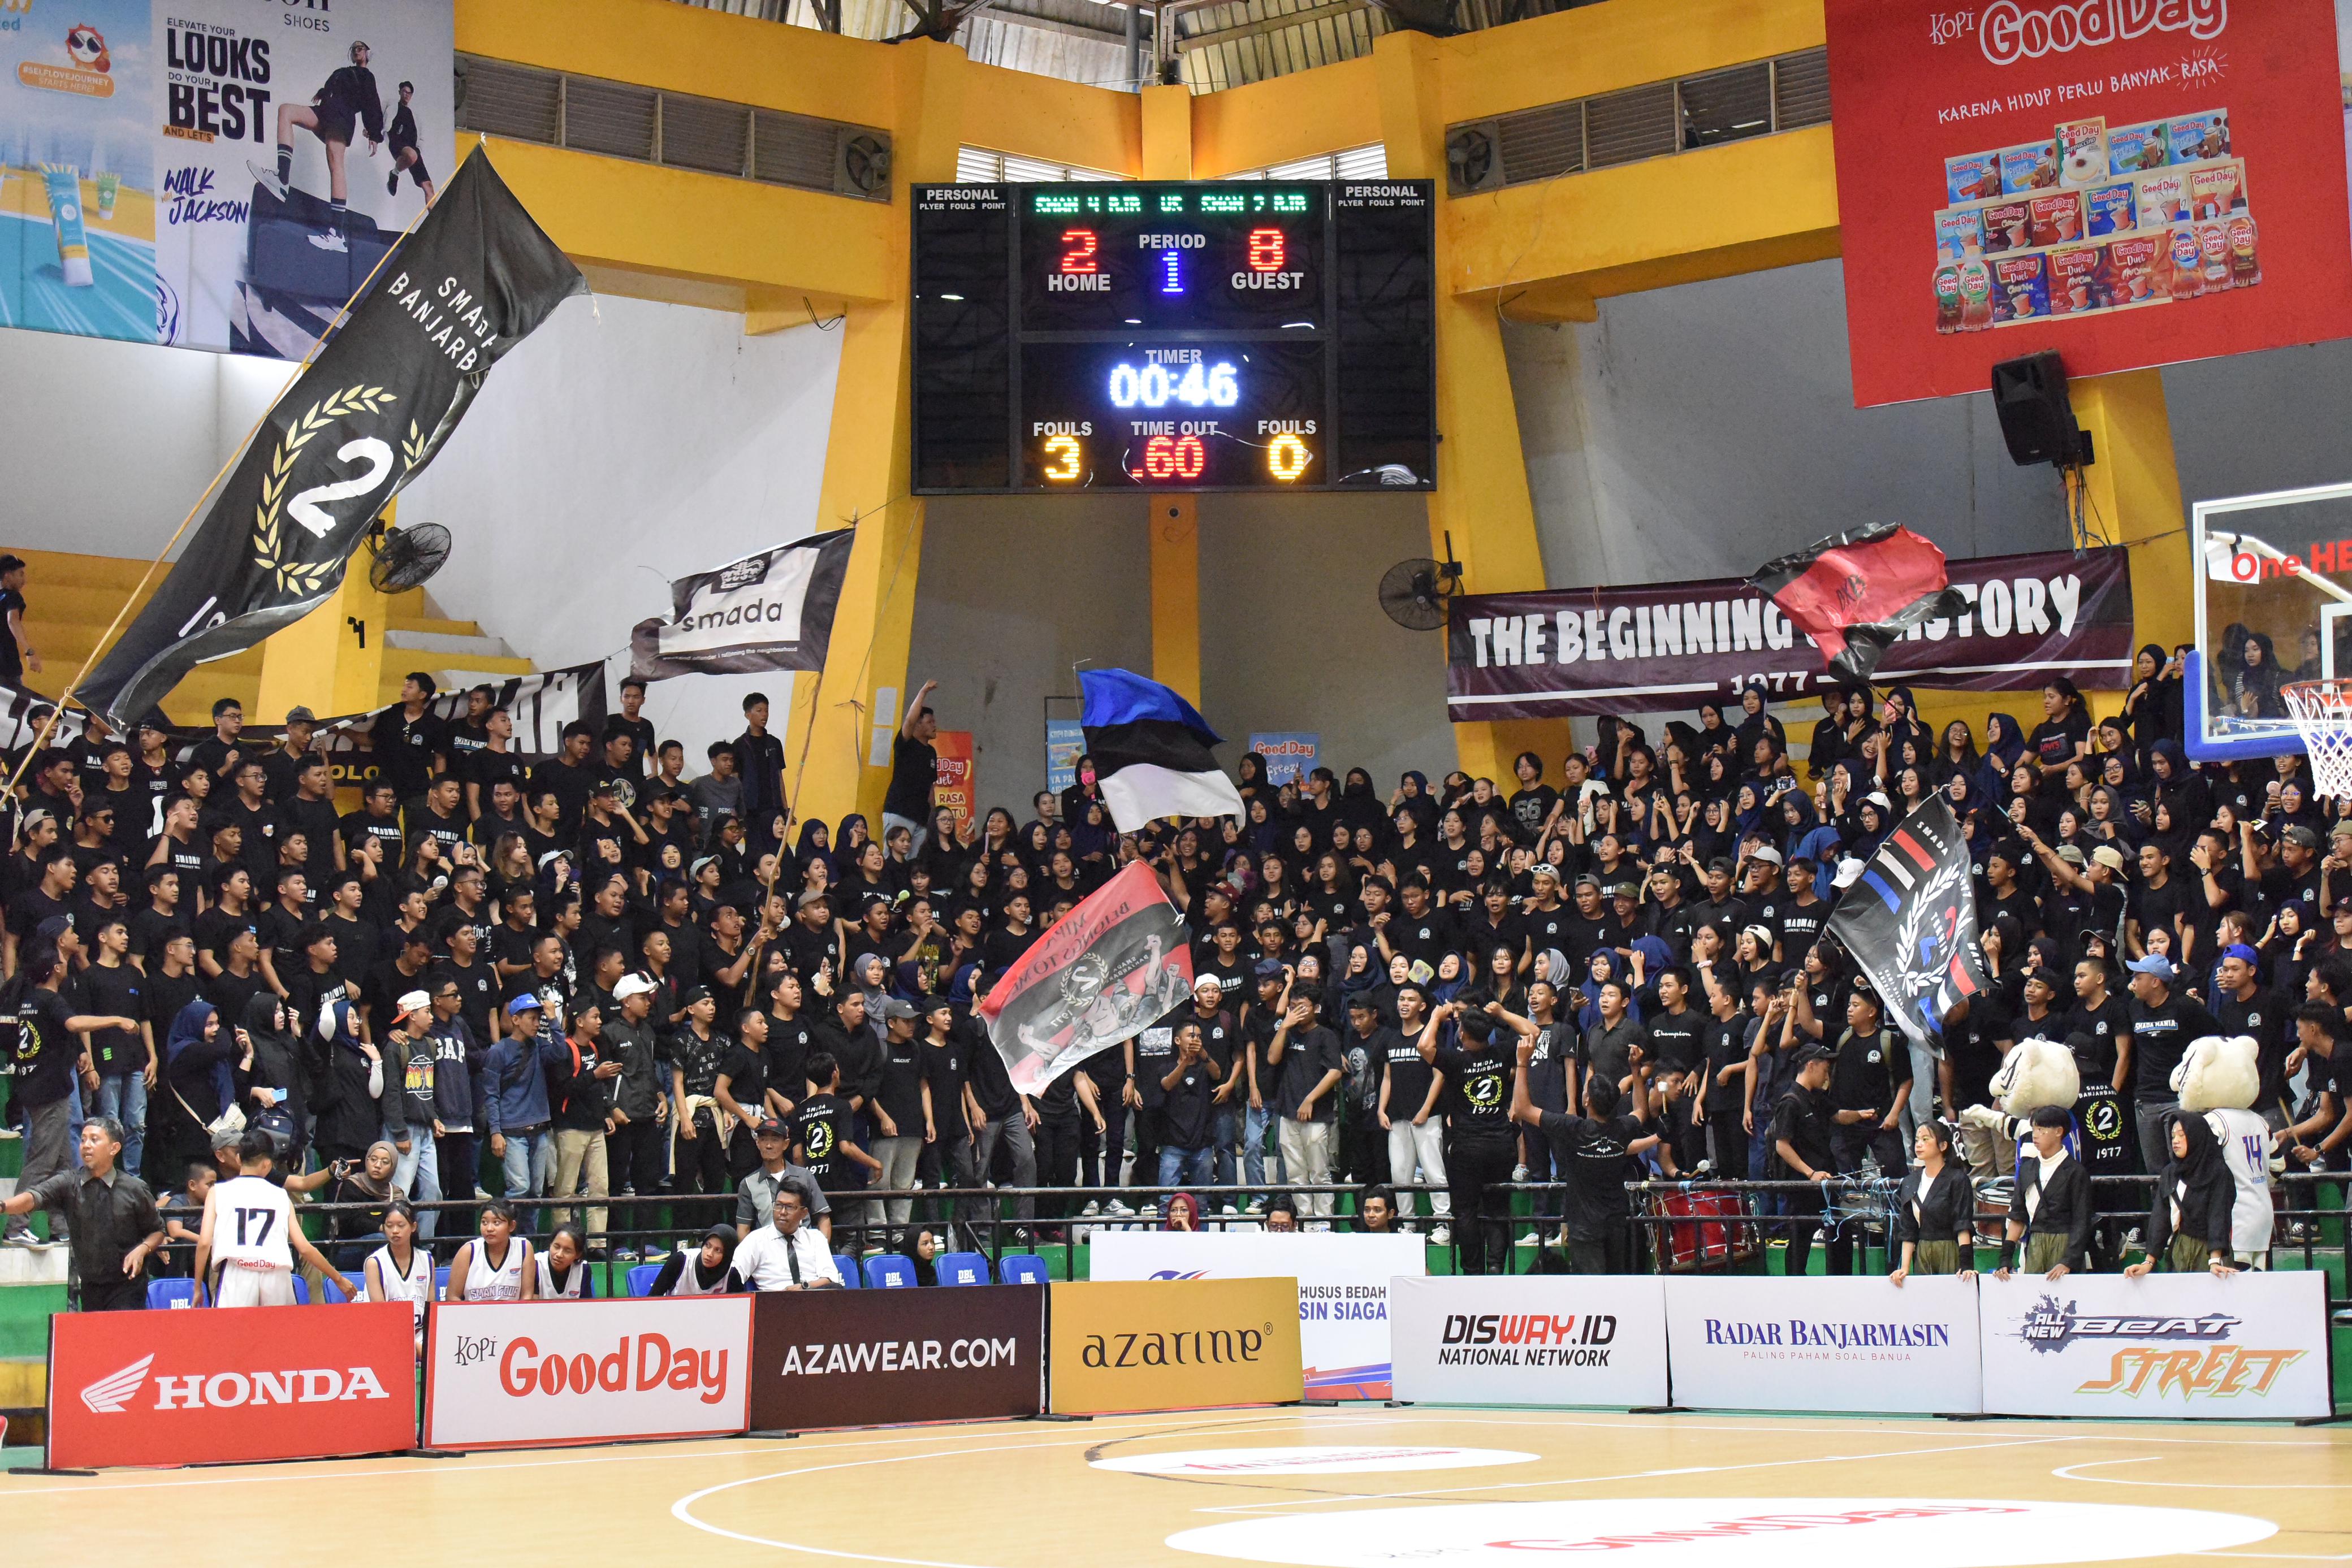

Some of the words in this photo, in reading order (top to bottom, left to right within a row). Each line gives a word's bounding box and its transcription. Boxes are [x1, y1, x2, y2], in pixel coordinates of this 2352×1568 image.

[167, 18, 207, 32] ELEVATE
[210, 25, 235, 37] YOUR
[284, 14, 330, 32] SHOES
[1979, 0, 2115, 65] Good
[167, 28, 270, 84] LOOKS
[23, 66, 109, 86] #SELFLOVEJOURNEY
[168, 72, 182, 81] DO
[185, 75, 211, 86] YOUR
[38, 78, 68, 89] STARTS
[1938, 99, 2002, 124] KARENA
[2007, 88, 2051, 111] HIDUP
[2058, 80, 2103, 102] PERLU
[2111, 66, 2170, 92] BANYAK
[2181, 58, 2219, 80] RASA
[168, 82, 271, 143] BEST
[164, 126, 184, 137] AND
[187, 131, 211, 141] LET'S
[2059, 128, 2081, 140] Good
[2082, 125, 2100, 137] Day
[2172, 124, 2189, 132] Good
[2190, 122, 2204, 130] Day
[2111, 136, 2128, 144] Good
[2129, 133, 2143, 141] Day
[2005, 153, 2021, 163] Good
[2022, 151, 2036, 160] Day
[1951, 164, 1968, 172] Good
[1969, 162, 1982, 170] Day
[163, 167, 214, 196] WALK
[2195, 175, 2215, 185] Good
[2217, 171, 2233, 181] Day
[1346, 185, 1418, 197] PERSONAL
[2142, 183, 2162, 193] Good
[2164, 180, 2180, 190] Day
[927, 189, 998, 200] PERSONAL
[2092, 193, 2111, 202] Good
[2112, 189, 2128, 200] Day
[169, 196, 249, 225] JACKSON
[2037, 201, 2057, 212] Good
[2058, 198, 2074, 210] Day
[1988, 209, 2008, 220] Good
[2009, 207, 2024, 218] Day
[1942, 218, 1960, 227] Good
[1961, 216, 1977, 226] Day
[2203, 232, 2223, 243] Good
[2230, 227, 2252, 238] Good
[1139, 234, 1205, 249] PERIOD
[2174, 240, 2195, 250] Good
[2206, 241, 2223, 251] Day
[2233, 235, 2251, 245] Day
[1062, 231, 1096, 272] 2
[1250, 228, 1283, 271] 8
[2117, 245, 2137, 255] Good
[2138, 242, 2153, 253] Day
[2177, 247, 2194, 257] Day
[2001, 262, 2020, 273] Good
[2021, 259, 2035, 270] Day
[2058, 255, 2077, 266] Good
[2078, 253, 2092, 264] Day
[2127, 255, 2145, 266] Duet
[1162, 252, 1183, 292] 1
[2068, 265, 2086, 275] Duet
[1048, 274, 1111, 291] HOME
[1231, 272, 1304, 289] GUEST
[1938, 275, 1957, 286] Good
[1965, 274, 1984, 284] Good
[2011, 272, 2028, 283] Duet
[1940, 284, 1956, 293] Day
[1968, 282, 1983, 291] Day
[1145, 349, 1203, 363] TIMER
[1110, 363, 1238, 406] 00:46
[1033, 422, 1092, 436] FOULS
[1131, 421, 1175, 435] TIME
[1181, 421, 1218, 435] OUT
[1257, 420, 1317, 434] FOULS
[1045, 436, 1079, 479] 3
[1269, 435, 1304, 479] 0
[287, 436, 394, 539] 2
[2231, 553, 2302, 582] One
[682, 598, 782, 632] smada
[1469, 615, 1546, 668] THE
[1555, 598, 1792, 665] BEGINNING
[1255, 741, 1287, 755] Good
[1289, 740, 1315, 759] Day
[939, 792, 966, 803] RASA
[1515, 798, 1541, 821] 66
[1917, 821, 1948, 856] SMADA
[2135, 1021, 2155, 1030] SMADA
[2155, 1019, 2176, 1028] MANIA
[1653, 1028, 1692, 1038] Champion
[434, 1038, 465, 1063] GAP
[1476, 1078, 1492, 1099] 2
[2097, 1107, 2113, 1130] 2
[810, 1127, 823, 1149] 2
[2096, 1146, 2121, 1159] 1977
[2242, 1134, 2262, 1174] 14
[235, 1207, 276, 1246] 17
[237, 1259, 259, 1268] Good
[260, 1259, 275, 1270] Day
[885, 1272, 902, 1282] DBL
[958, 1269, 975, 1279] DBL
[1021, 1272, 1036, 1281] DBL
[470, 1288, 496, 1300] SMAN
[1346, 1286, 1386, 1298] BEDAH
[1334, 1302, 1387, 1320] SIAGA
[2034, 1313, 2065, 1325] ALL
[1442, 1314, 1617, 1345] DISWAY.ID
[1704, 1319, 1782, 1345] RADAR
[1788, 1320, 1949, 1348] BANJARMASIN
[2026, 1326, 2065, 1339] NEW
[781, 1336, 1016, 1376] AZAWEAR.COM
[1438, 1348, 1521, 1366] NATIONAL
[1524, 1349, 1610, 1367] NETWORK
[1744, 1350, 1786, 1360] PALING
[1791, 1352, 1832, 1361] PAHAM
[1836, 1352, 1866, 1361] SOAL
[1871, 1353, 1912, 1362] BANUA
[499, 1335, 629, 1398] Good
[634, 1332, 728, 1405] Day
[2073, 1344, 2310, 1403] STREET
[154, 1367, 390, 1410] HONDA
